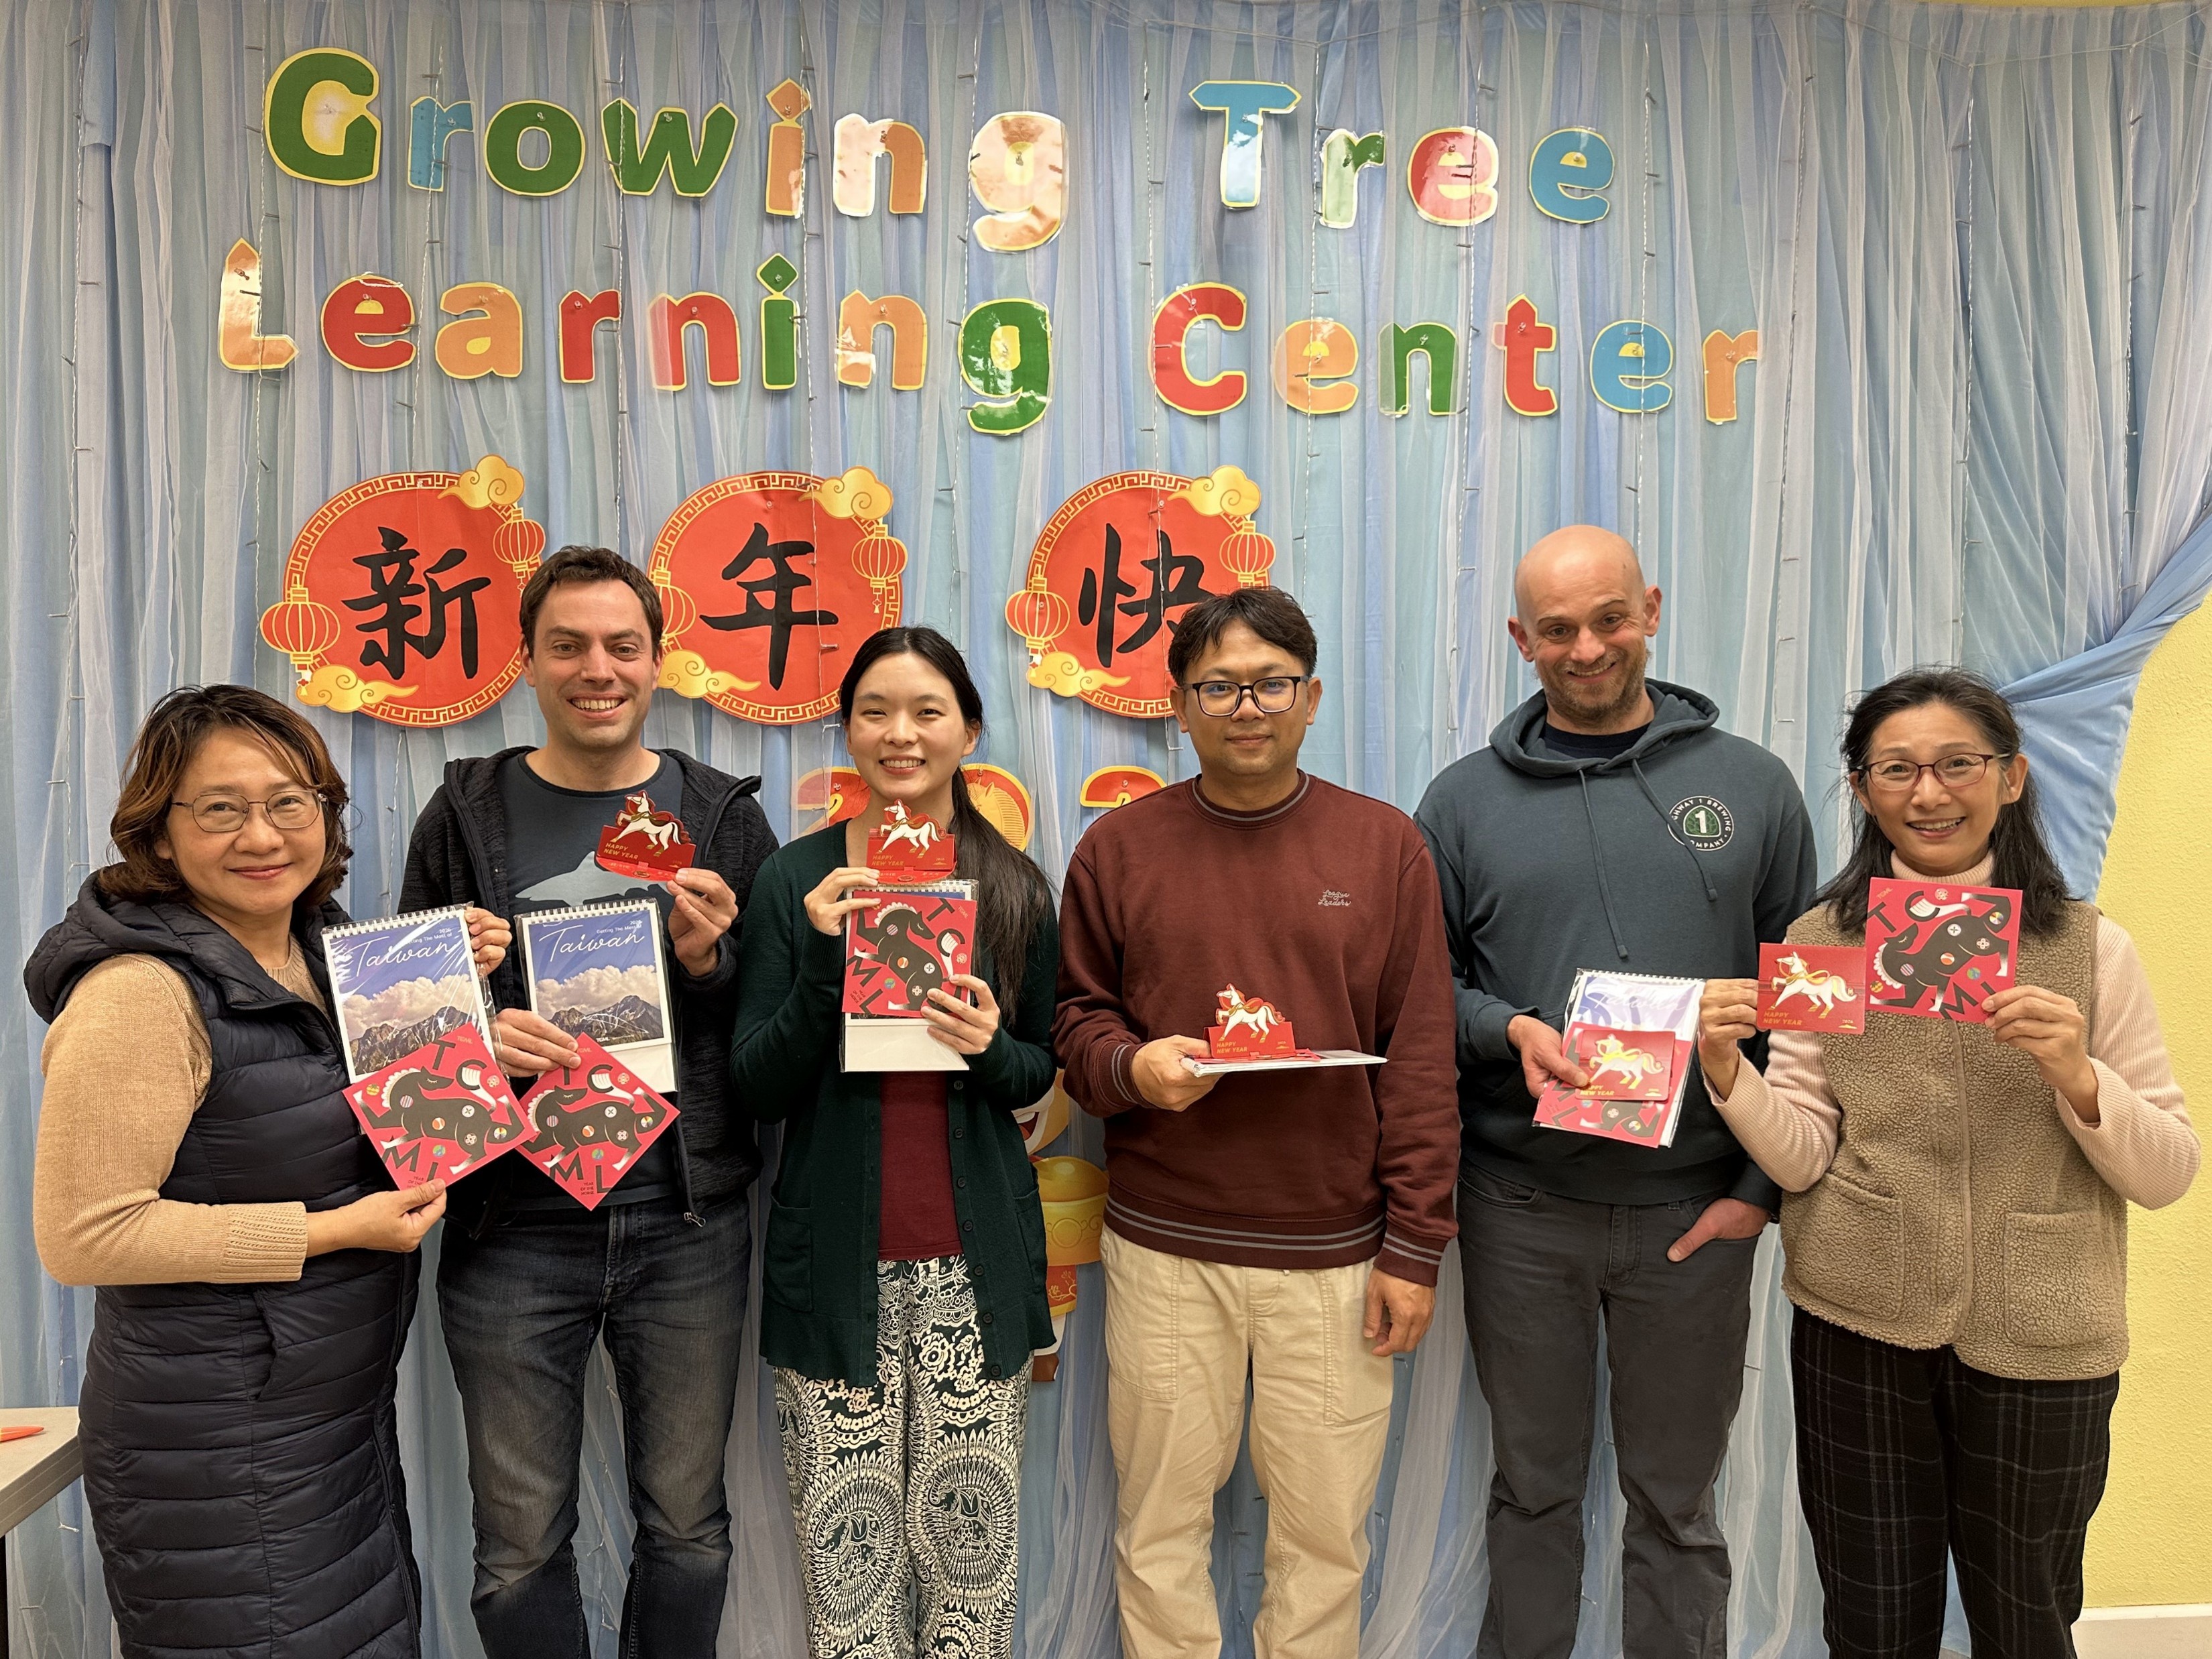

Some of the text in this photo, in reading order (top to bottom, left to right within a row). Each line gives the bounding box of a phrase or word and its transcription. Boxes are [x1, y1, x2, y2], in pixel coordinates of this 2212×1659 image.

[265, 48, 1614, 252] Growing Tree
[219, 238, 1759, 435] Learning Center
[1671, 800, 1695, 820] GHWAY
[1707, 800, 1731, 831] BREWING
[1695, 810, 1707, 833] 1
[605, 843, 628, 851] HAPPY
[621, 851, 639, 859] YEAR
[1691, 838, 1725, 848] MPANY
[1322, 889, 1350, 900] League
[344, 936, 457, 977] Taiwan
[539, 924, 646, 963] Taiwan
